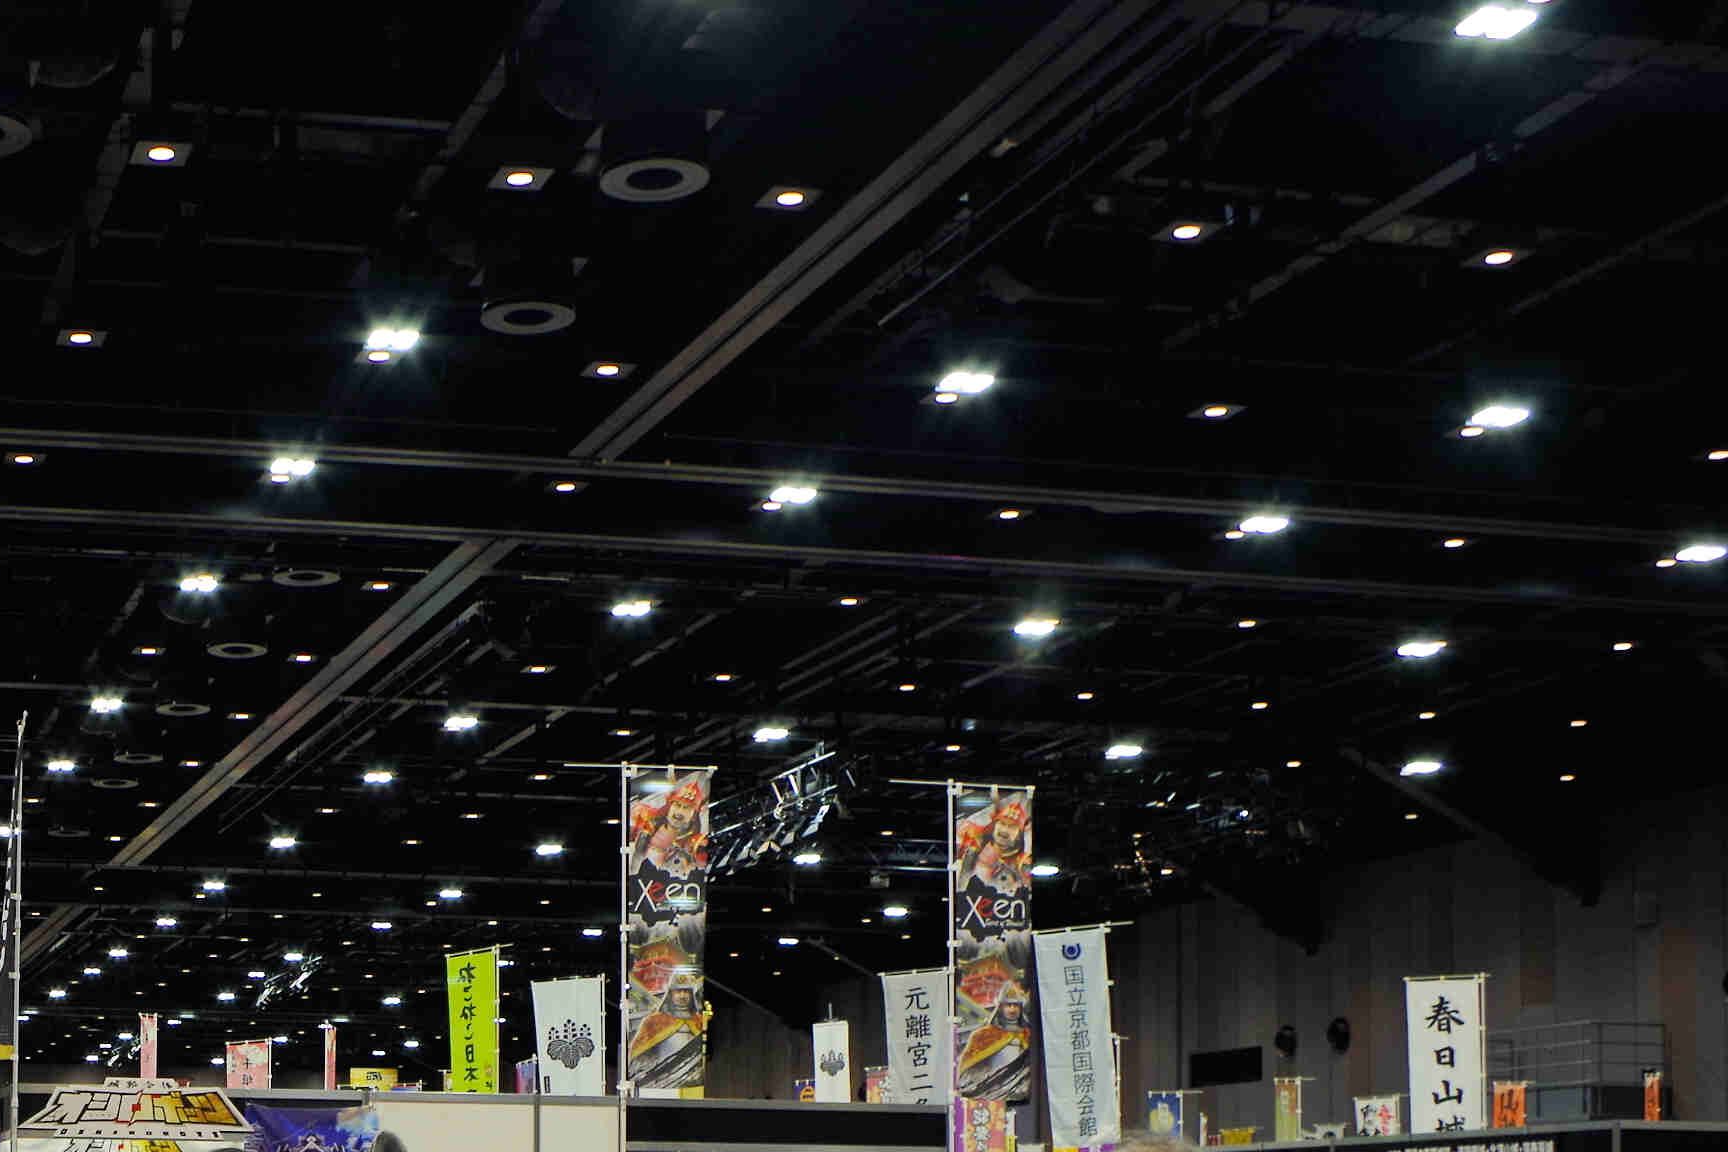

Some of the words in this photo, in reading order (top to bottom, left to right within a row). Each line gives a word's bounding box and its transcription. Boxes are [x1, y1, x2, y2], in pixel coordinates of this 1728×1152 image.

[1064, 965, 1098, 1138] 国立京都国際会館
